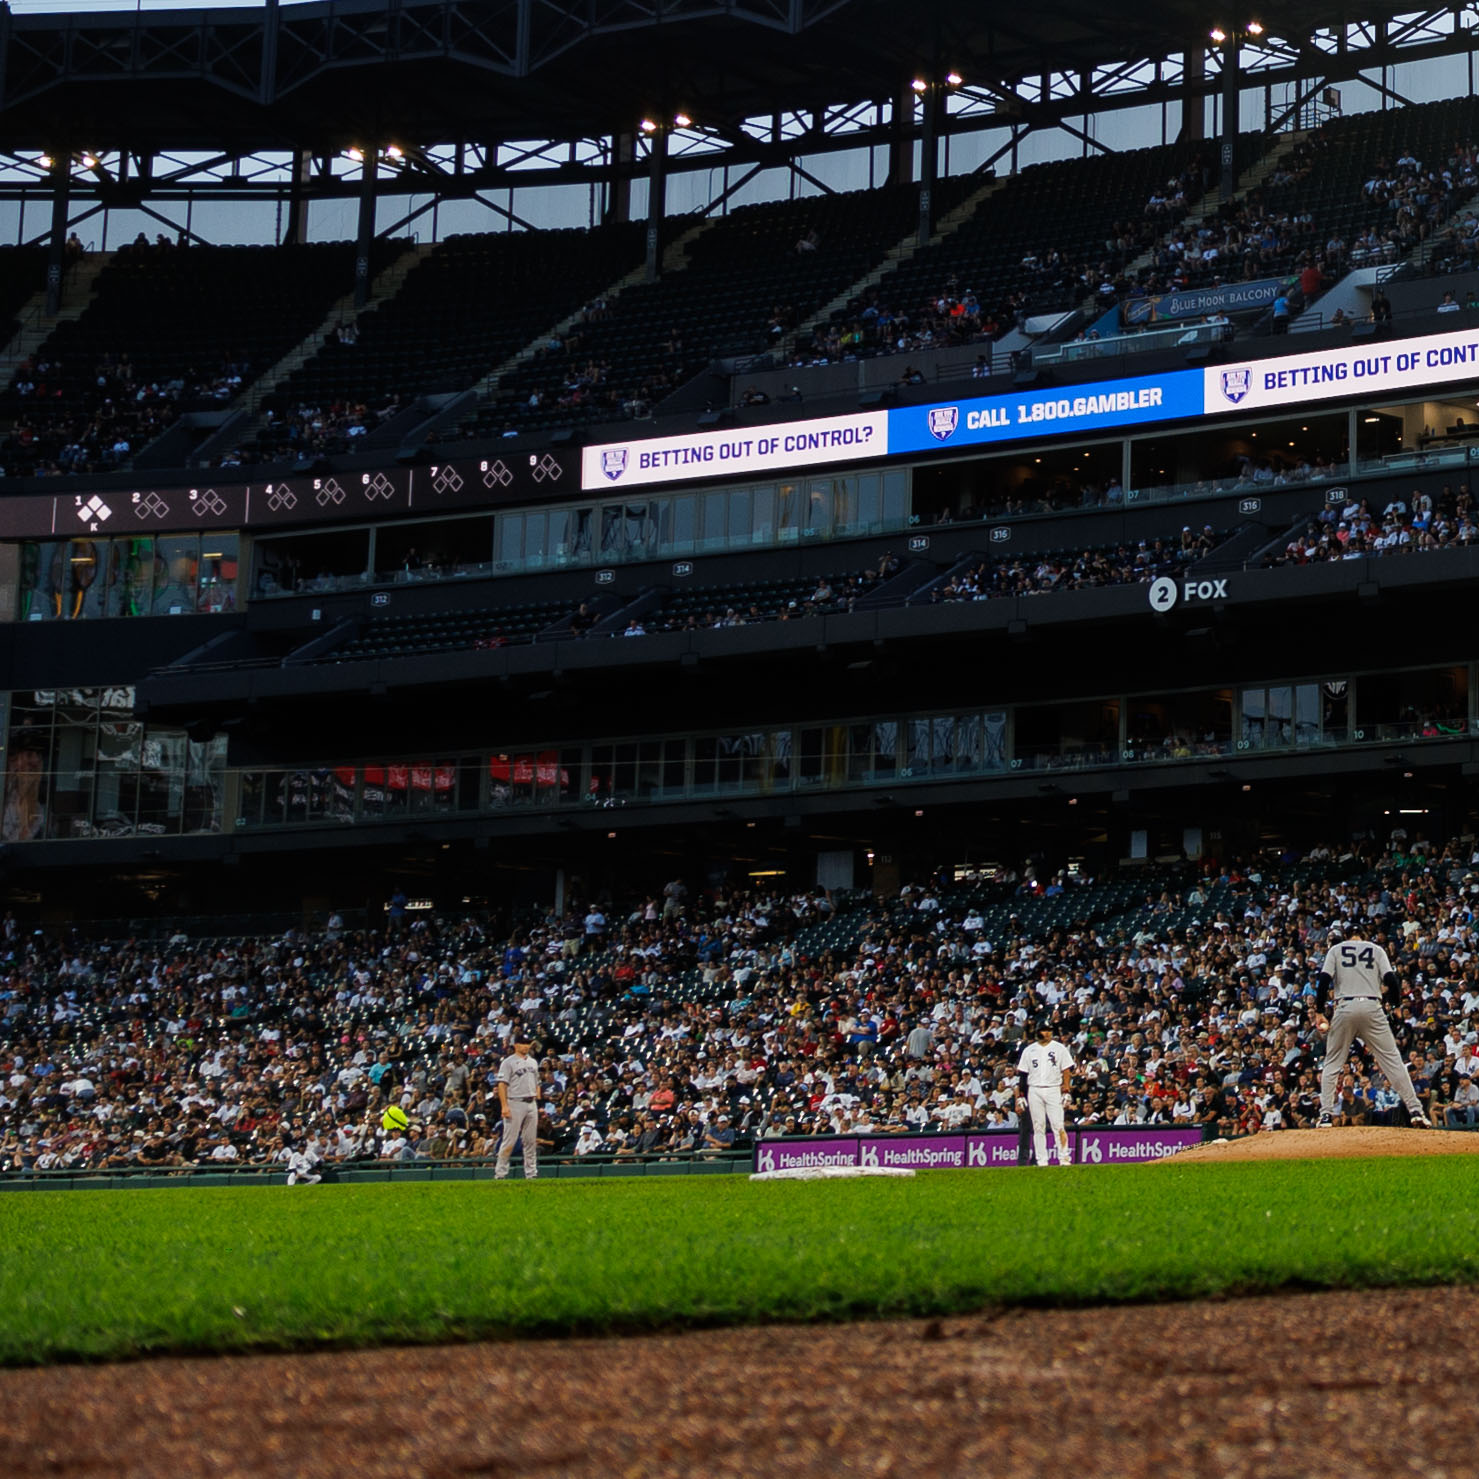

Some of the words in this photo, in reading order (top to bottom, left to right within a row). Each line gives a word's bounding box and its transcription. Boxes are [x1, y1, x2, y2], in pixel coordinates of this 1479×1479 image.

[1198, 295, 1225, 308] MOON
[1230, 286, 1278, 304] BALCONY
[1264, 362, 1348, 390] BETTING
[1353, 357, 1390, 377] OUT
[1397, 352, 1420, 372] OF
[967, 407, 1010, 430] CALL
[1017, 387, 1163, 424] 1.800.GAMBLER
[640, 446, 713, 468] BETTING
[719, 441, 751, 459] OUT
[757, 437, 778, 455] OF
[784, 426, 873, 452] CONTROL?
[530, 456, 537, 466] 9
[480, 462, 488, 471] 8
[430, 467, 438, 477] 7
[362, 474, 370, 484] 6
[265, 485, 273, 494] 4
[314, 480, 321, 489] 5
[132, 493, 140, 503] 2
[189, 490, 198, 500] 3
[75, 496, 82, 505] 1
[90, 523, 98, 531] K
[1157, 585, 1169, 603] 2
[1183, 579, 1229, 601] FOX
[1341, 946, 1374, 970] 54
[1032, 1060, 1039, 1068] 5
[780, 1152, 855, 1168] HealthSpring
[884, 1150, 961, 1167] HealthSpring
